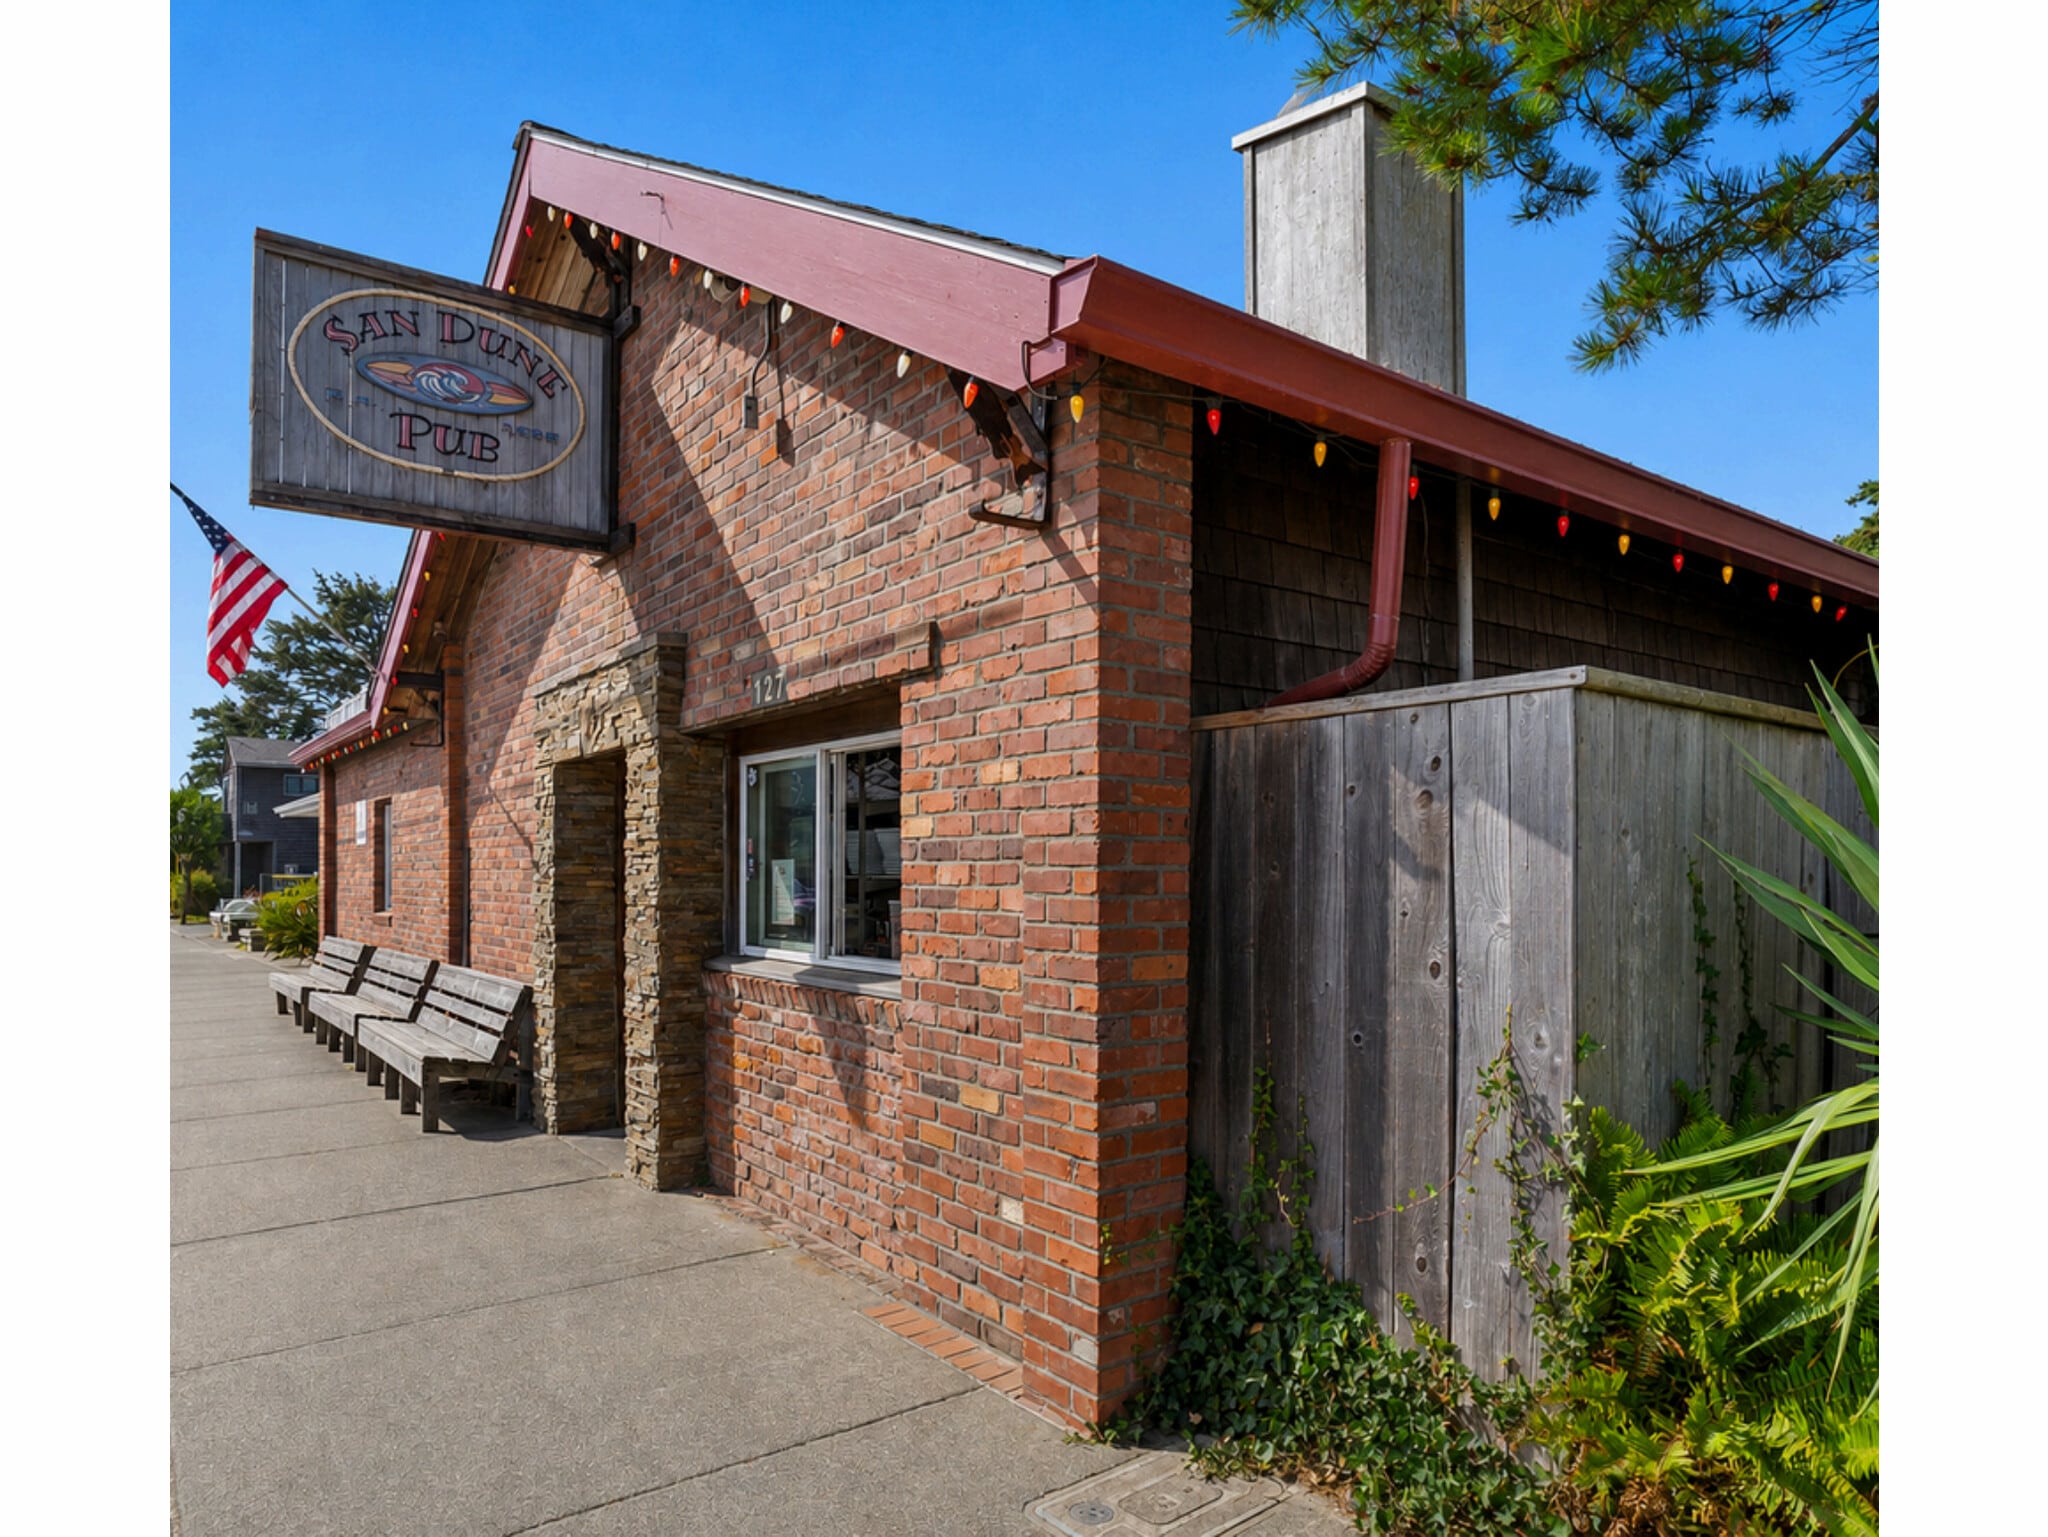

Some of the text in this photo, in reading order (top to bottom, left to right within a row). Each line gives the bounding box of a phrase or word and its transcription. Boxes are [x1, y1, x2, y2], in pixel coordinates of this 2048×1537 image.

[323, 310, 569, 399] SAN DUNE
[389, 412, 501, 463] PUB
[754, 666, 786, 705] 127
